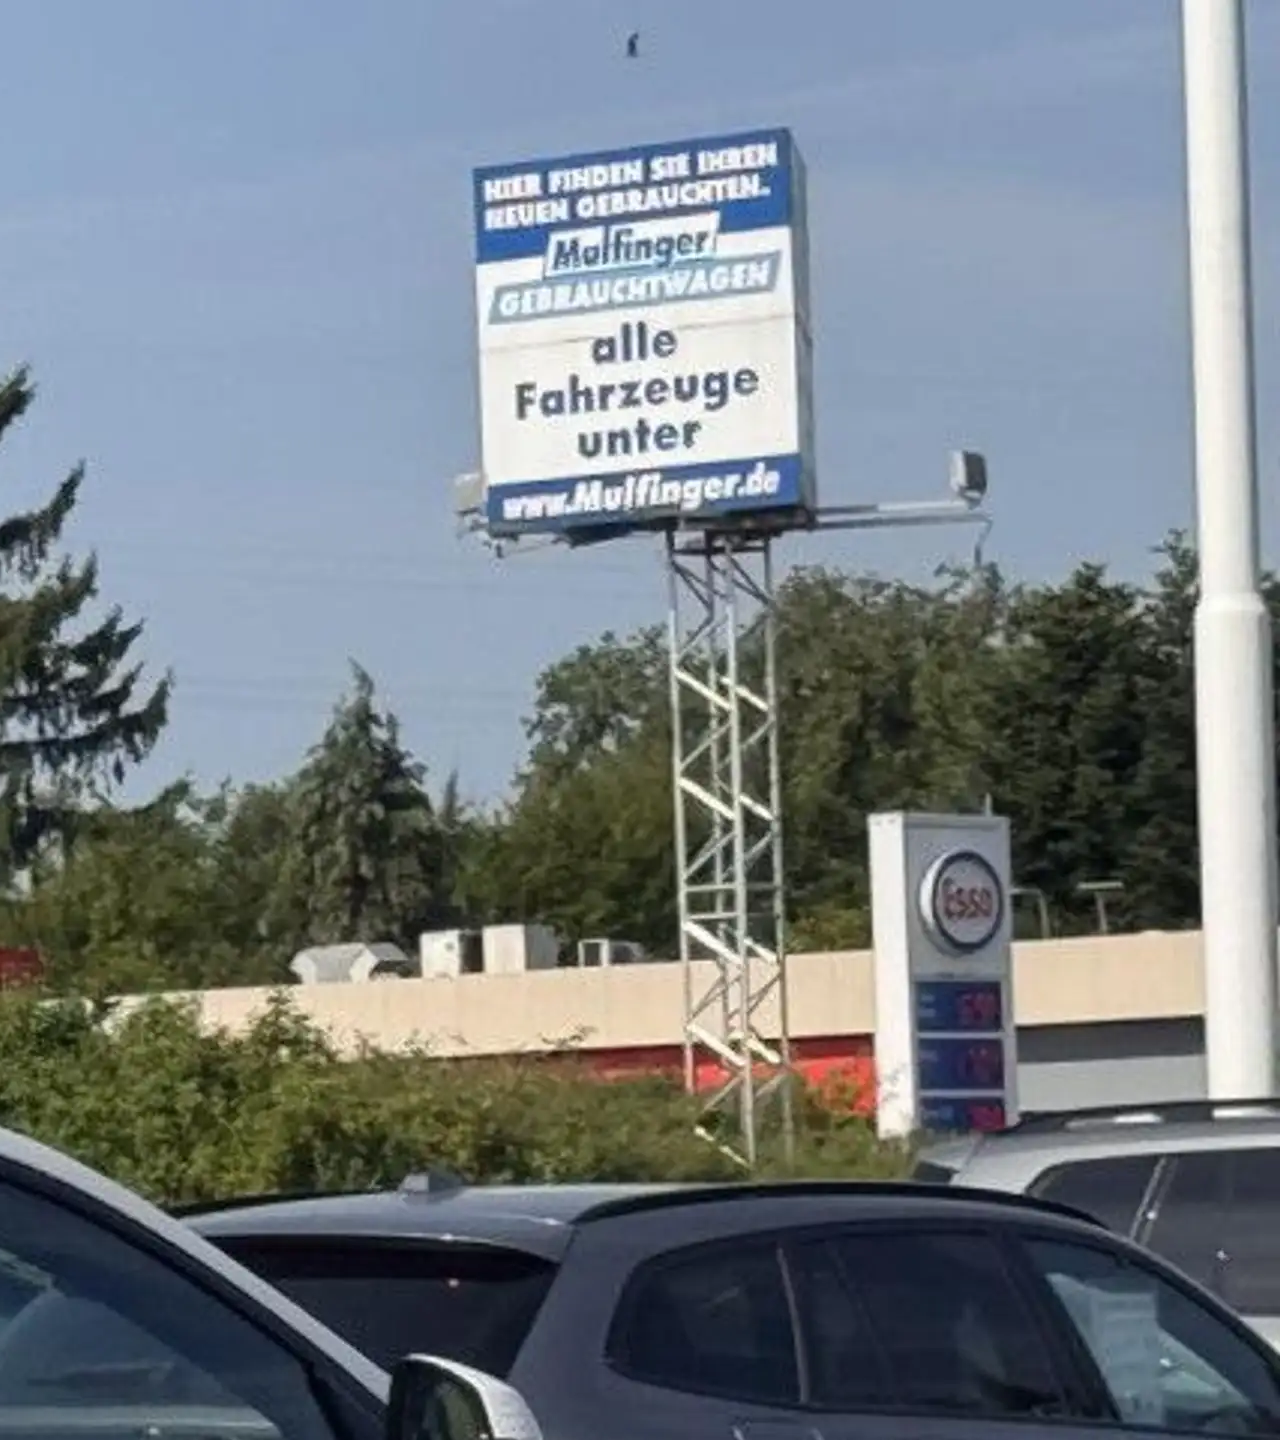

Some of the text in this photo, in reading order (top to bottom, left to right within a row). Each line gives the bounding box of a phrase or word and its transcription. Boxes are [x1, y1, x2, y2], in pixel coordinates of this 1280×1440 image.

[485, 142, 778, 202] HIER FINDEN SIE IHREN
[485, 200, 570, 231] NEUEN
[552, 227, 709, 270] Mulfinger
[499, 259, 771, 317] GEBRAUCHTWAGEN
[592, 321, 678, 365] alle
[515, 367, 760, 421] Fahrzeuge
[578, 417, 703, 458] unter
[502, 461, 781, 520] www.Mulfinger.de
[942, 877, 993, 919] Esso
